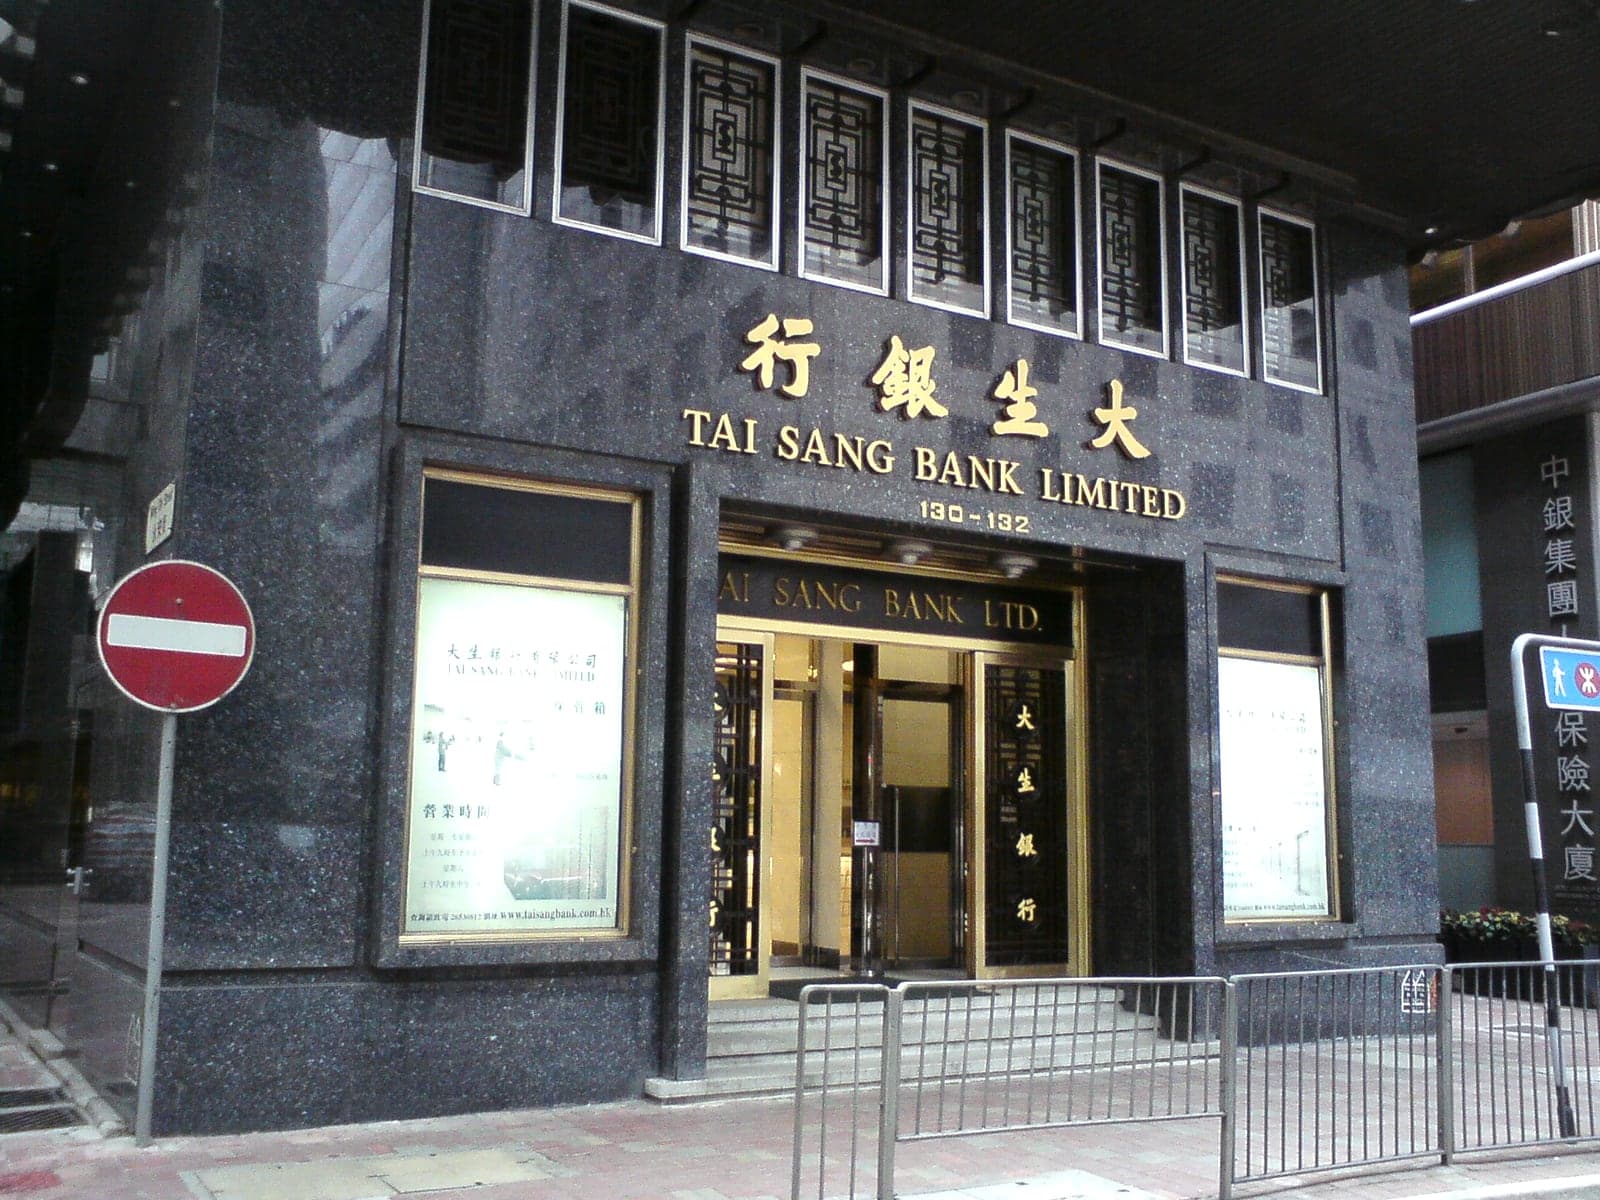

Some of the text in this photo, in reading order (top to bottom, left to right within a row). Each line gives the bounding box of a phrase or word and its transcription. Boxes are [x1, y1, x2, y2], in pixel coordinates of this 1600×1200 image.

[684, 409, 1186, 521] TAI SANG BANK LIMITED
[719, 571, 1043, 632] AI SANG BANK LTD.
[1541, 455, 1598, 881] 中銀集團保險大廈
